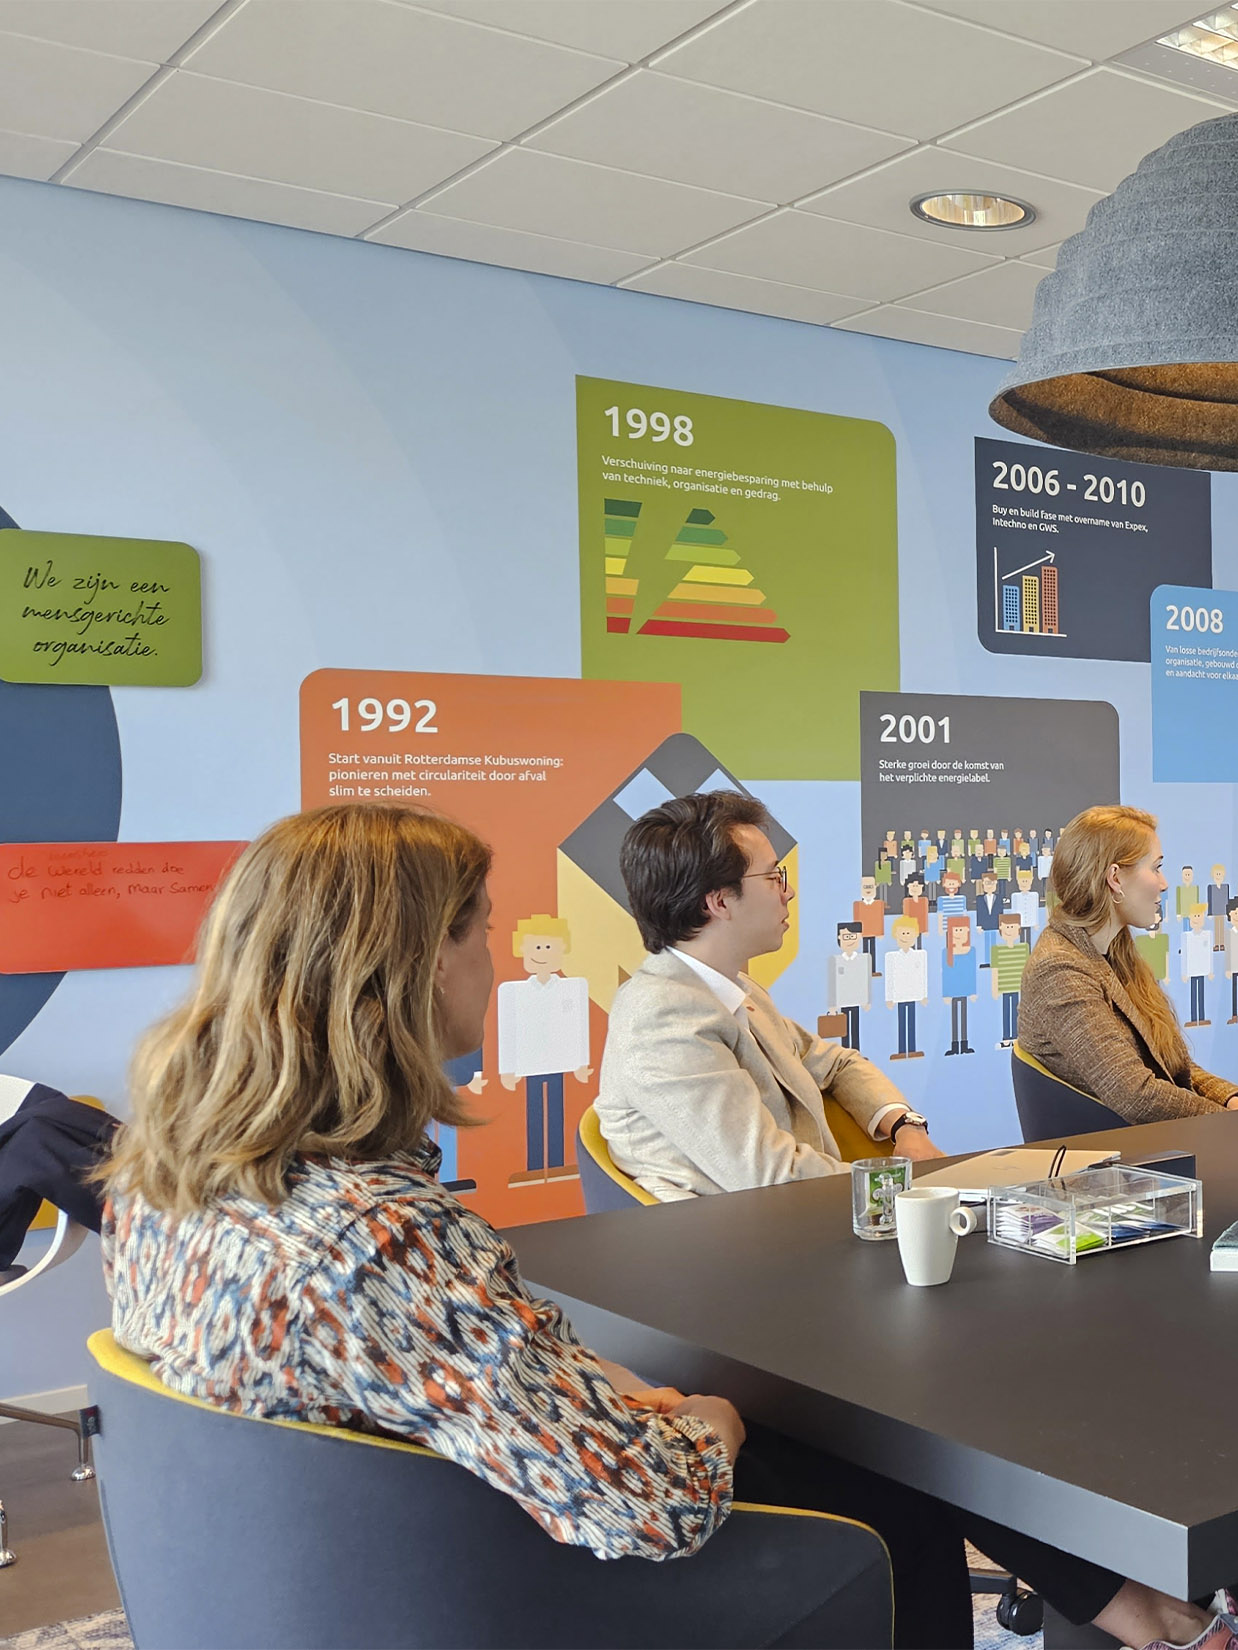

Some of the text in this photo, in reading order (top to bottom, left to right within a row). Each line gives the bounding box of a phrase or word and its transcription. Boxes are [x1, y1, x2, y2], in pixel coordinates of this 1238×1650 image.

[604, 406, 694, 446] 1998
[601, 455, 834, 494] Verschuiving naar energiebesparing met behulp
[602, 472, 781, 502] van techniek, organisatie en gedrag.
[992, 461, 1060, 496] 2006
[1083, 474, 1146, 508] 2010
[992, 504, 1149, 533] Buy en build fase met overname van Expex,
[992, 518, 1060, 534] Intechno en GWS.
[23, 560, 171, 605] We zijn een
[22, 600, 171, 635] mensgerichte
[1165, 604, 1224, 634] 2008
[33, 632, 158, 667] organisatie.
[1165, 645, 1178, 654] Van
[1179, 646, 1196, 655] losse
[1165, 657, 1204, 668] organisatie,
[1205, 660, 1235, 669] gebouwd
[1175, 670, 1206, 679] aandacht
[332, 697, 439, 733] 1992
[879, 714, 951, 744] 2001
[328, 753, 564, 768] Start vanuit Rotterdamse Kubuswoning:
[879, 759, 1004, 771] Sterke groei door de komst van
[328, 769, 546, 782] pionieren met circulariteit door afval
[879, 773, 990, 784] het verplichte energielabel.
[329, 785, 432, 797] slim te scheiden.
[8, 856, 185, 880] de wereld redden doe
[9, 888, 31, 904] je
[41, 884, 73, 900] niet
[80, 882, 121, 899] alleen,
